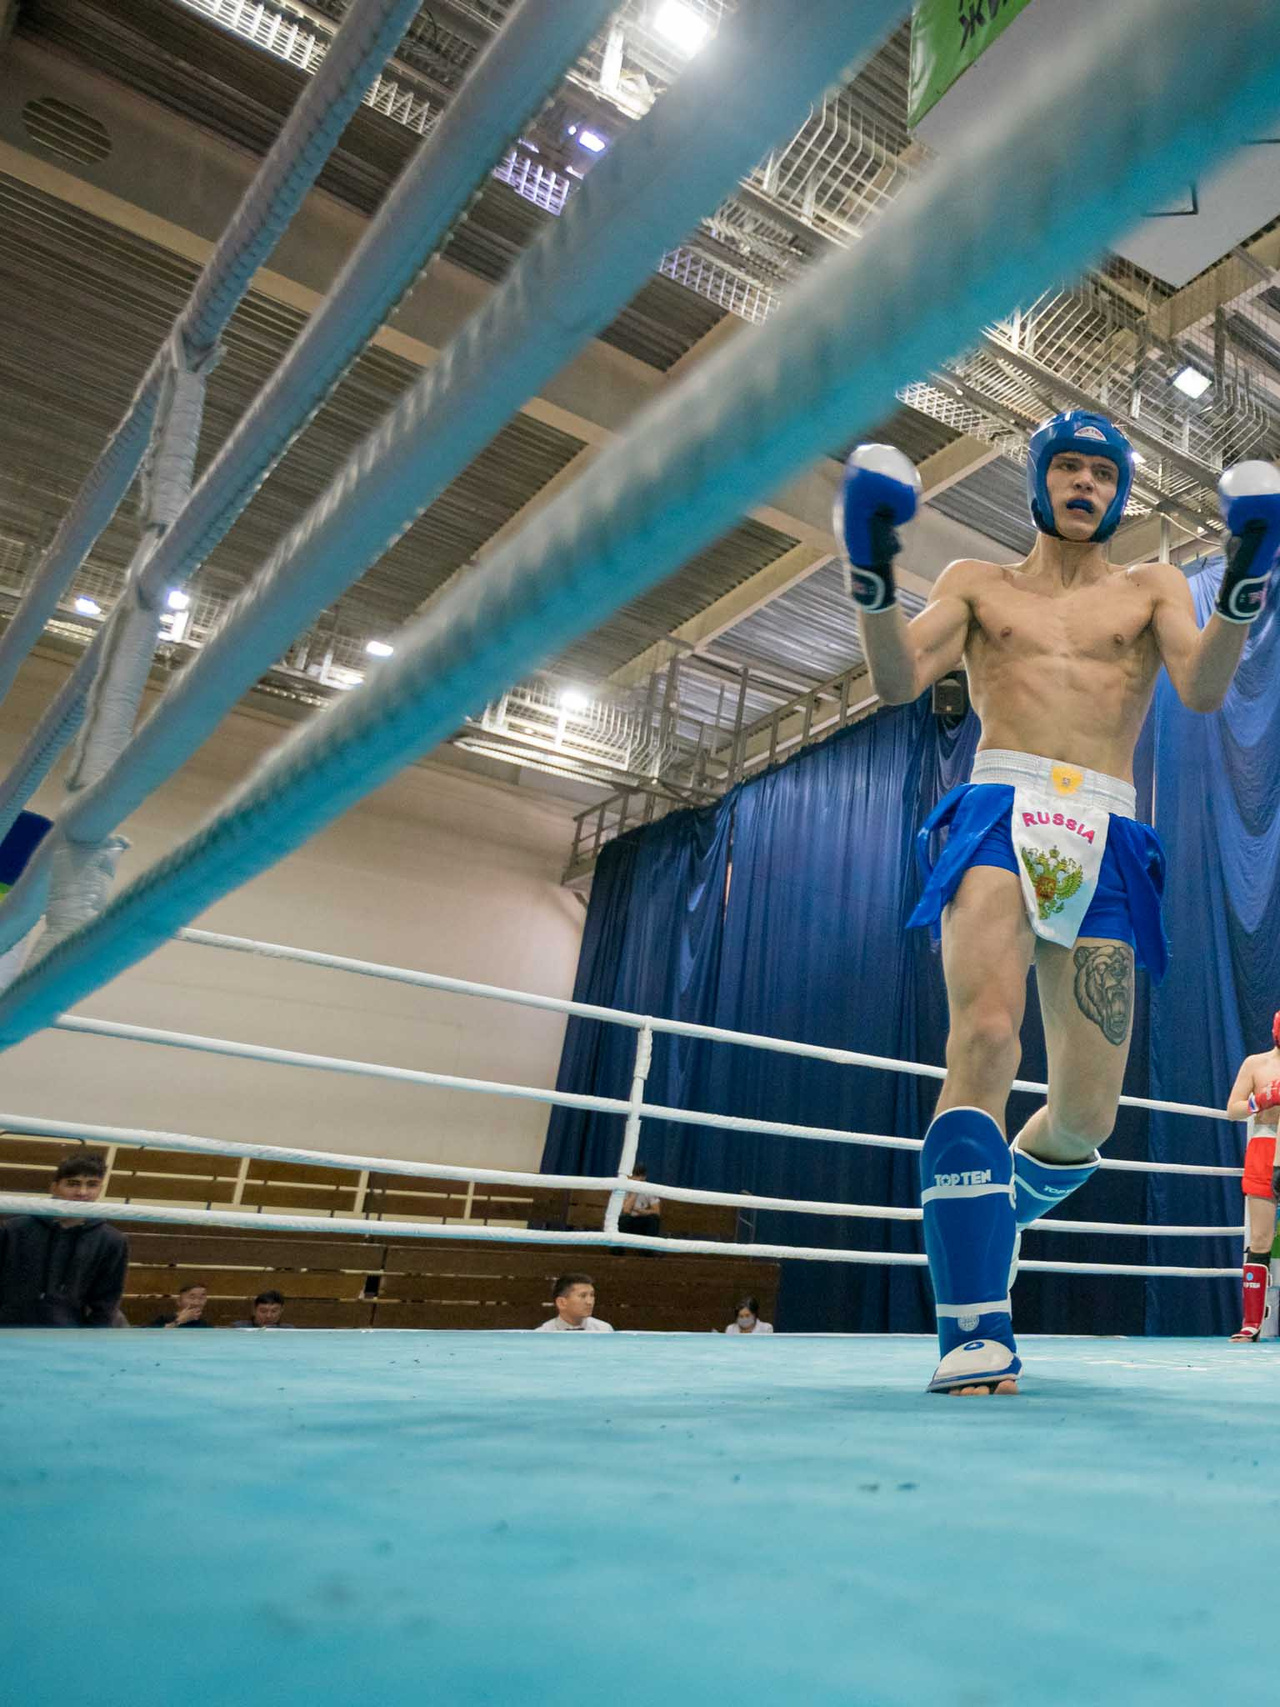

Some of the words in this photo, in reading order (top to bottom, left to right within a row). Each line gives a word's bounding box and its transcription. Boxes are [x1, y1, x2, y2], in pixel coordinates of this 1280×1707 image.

[1022, 812, 1095, 845] RUSSIA
[934, 1173, 960, 1187] TOP
[960, 1168, 992, 1185] TEN
